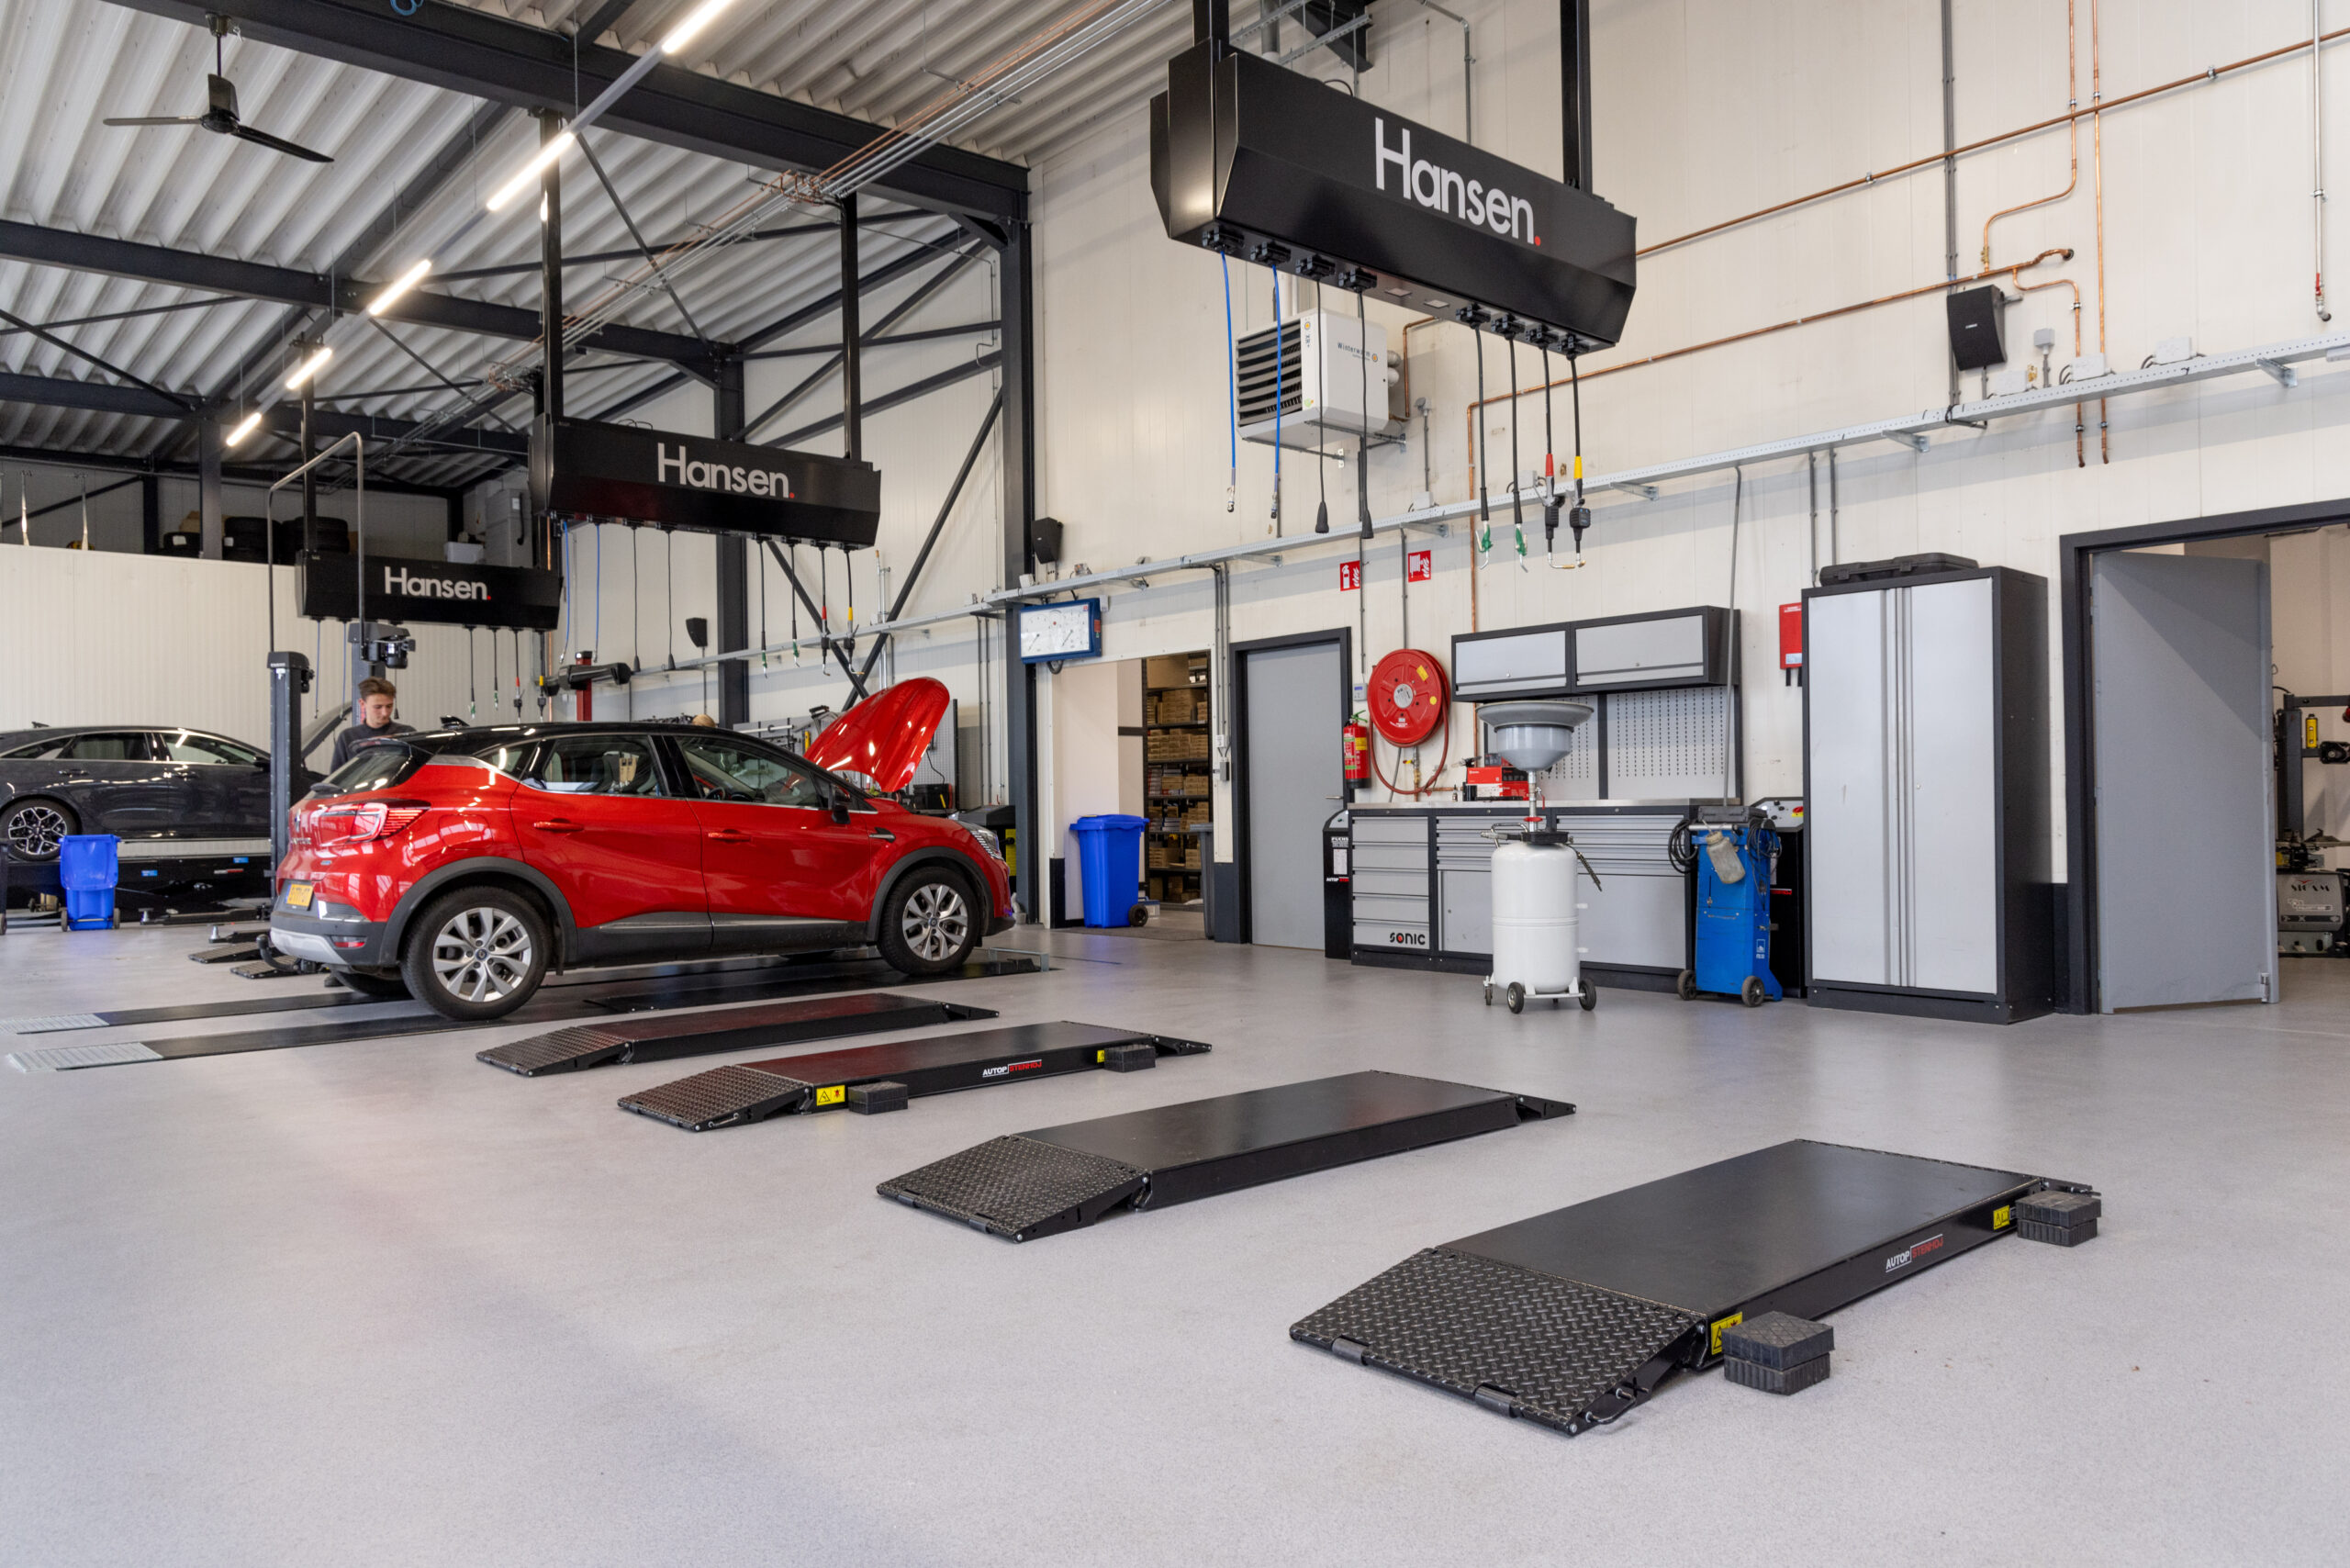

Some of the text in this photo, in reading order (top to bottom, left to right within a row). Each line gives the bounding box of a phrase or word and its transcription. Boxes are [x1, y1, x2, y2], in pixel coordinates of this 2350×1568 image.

[1375, 117, 1541, 246] Hansen.
[1337, 342, 1371, 357] Winterwam
[657, 442, 795, 498] Hansen.
[385, 566, 491, 600] Hansen.
[982, 1066, 1008, 1076] AUTOP
[1886, 1250, 1910, 1271] AUTOP
